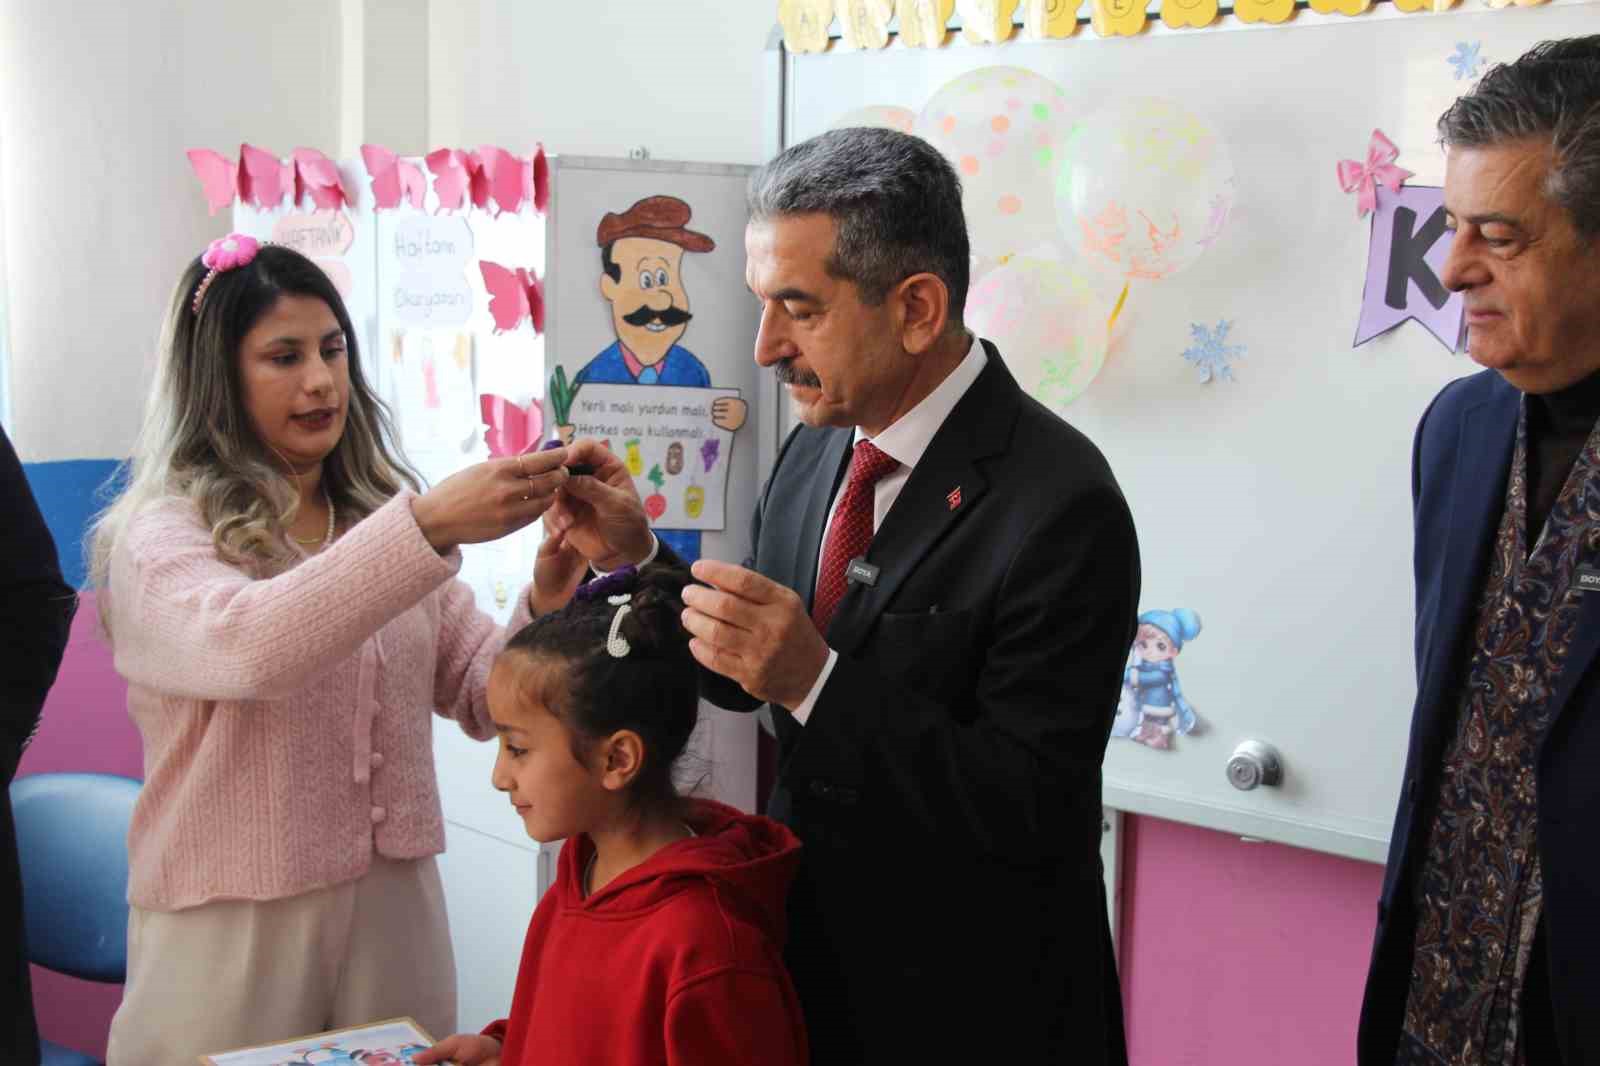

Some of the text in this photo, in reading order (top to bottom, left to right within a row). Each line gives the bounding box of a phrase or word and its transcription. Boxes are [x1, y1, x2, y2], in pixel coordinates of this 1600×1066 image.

[1384, 205, 1450, 310] K
[637, 402, 679, 417] yurdun
[578, 424, 619, 436] Herkes
[622, 426, 644, 438] onu
